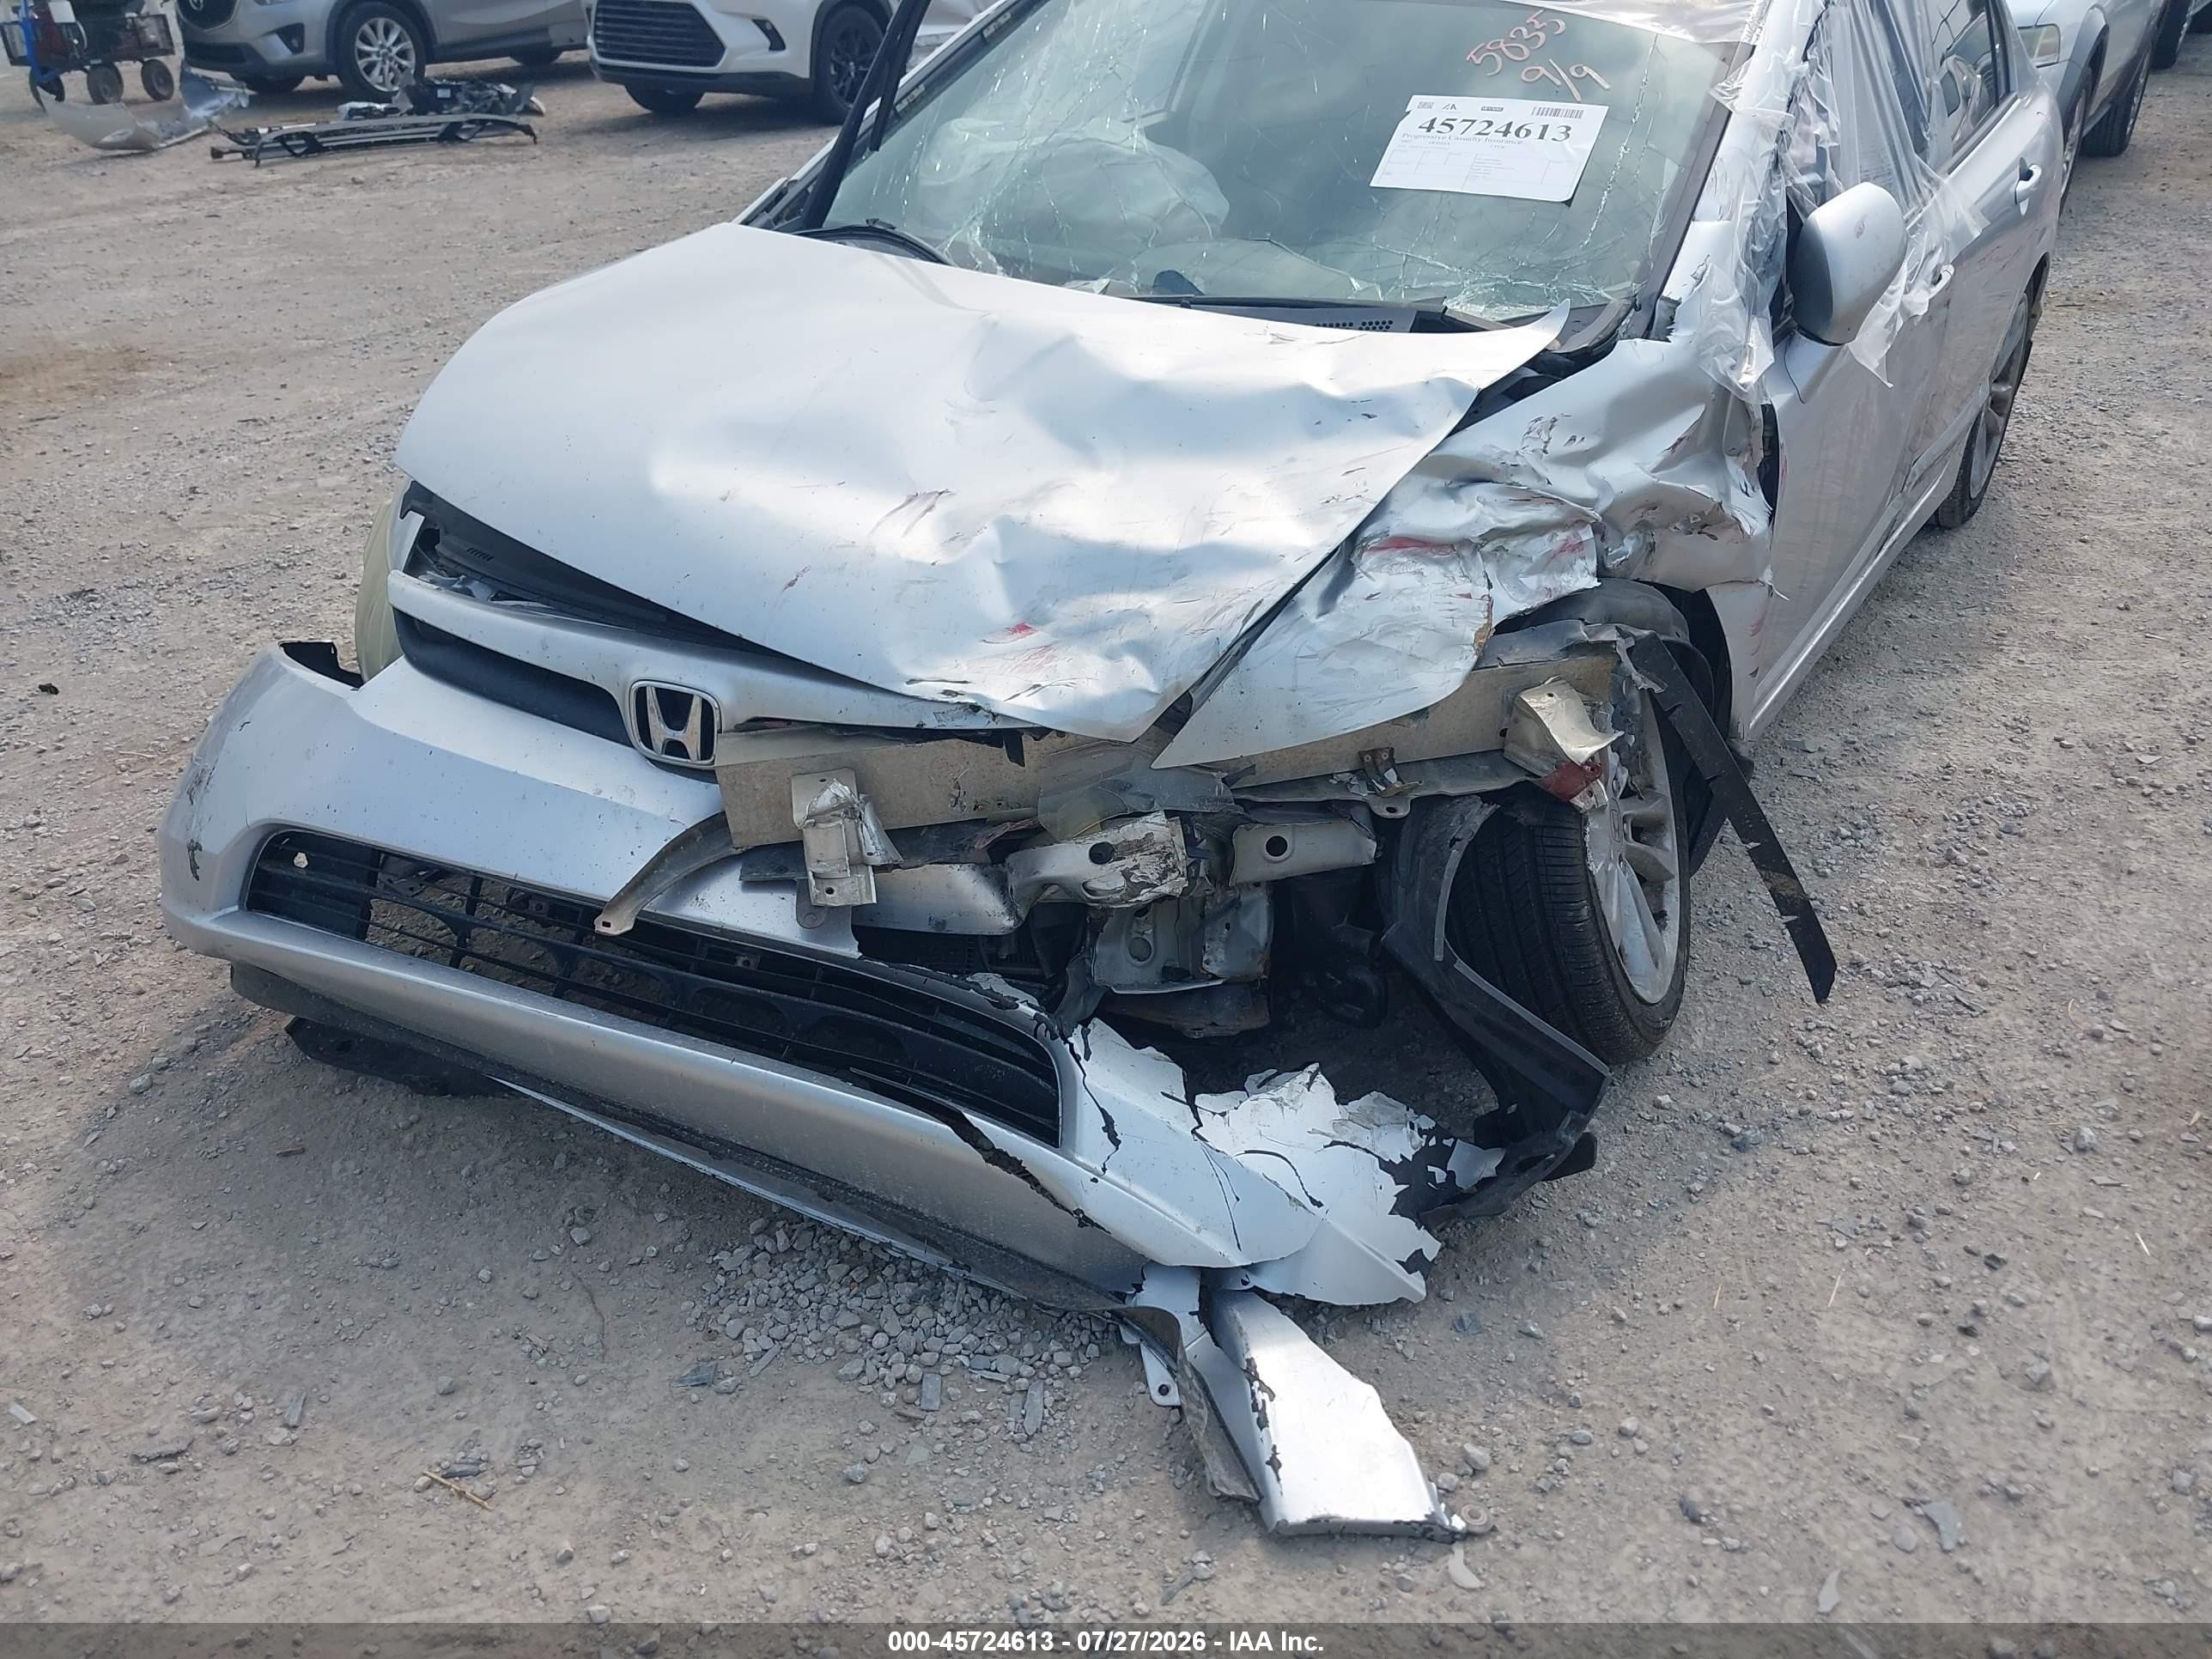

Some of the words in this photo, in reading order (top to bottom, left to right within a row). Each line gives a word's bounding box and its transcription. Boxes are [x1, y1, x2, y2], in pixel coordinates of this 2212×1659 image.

[1466, 9, 1566, 76] 5835
[1521, 58, 1612, 102] 9/9
[1417, 116, 1572, 143] 45724613
